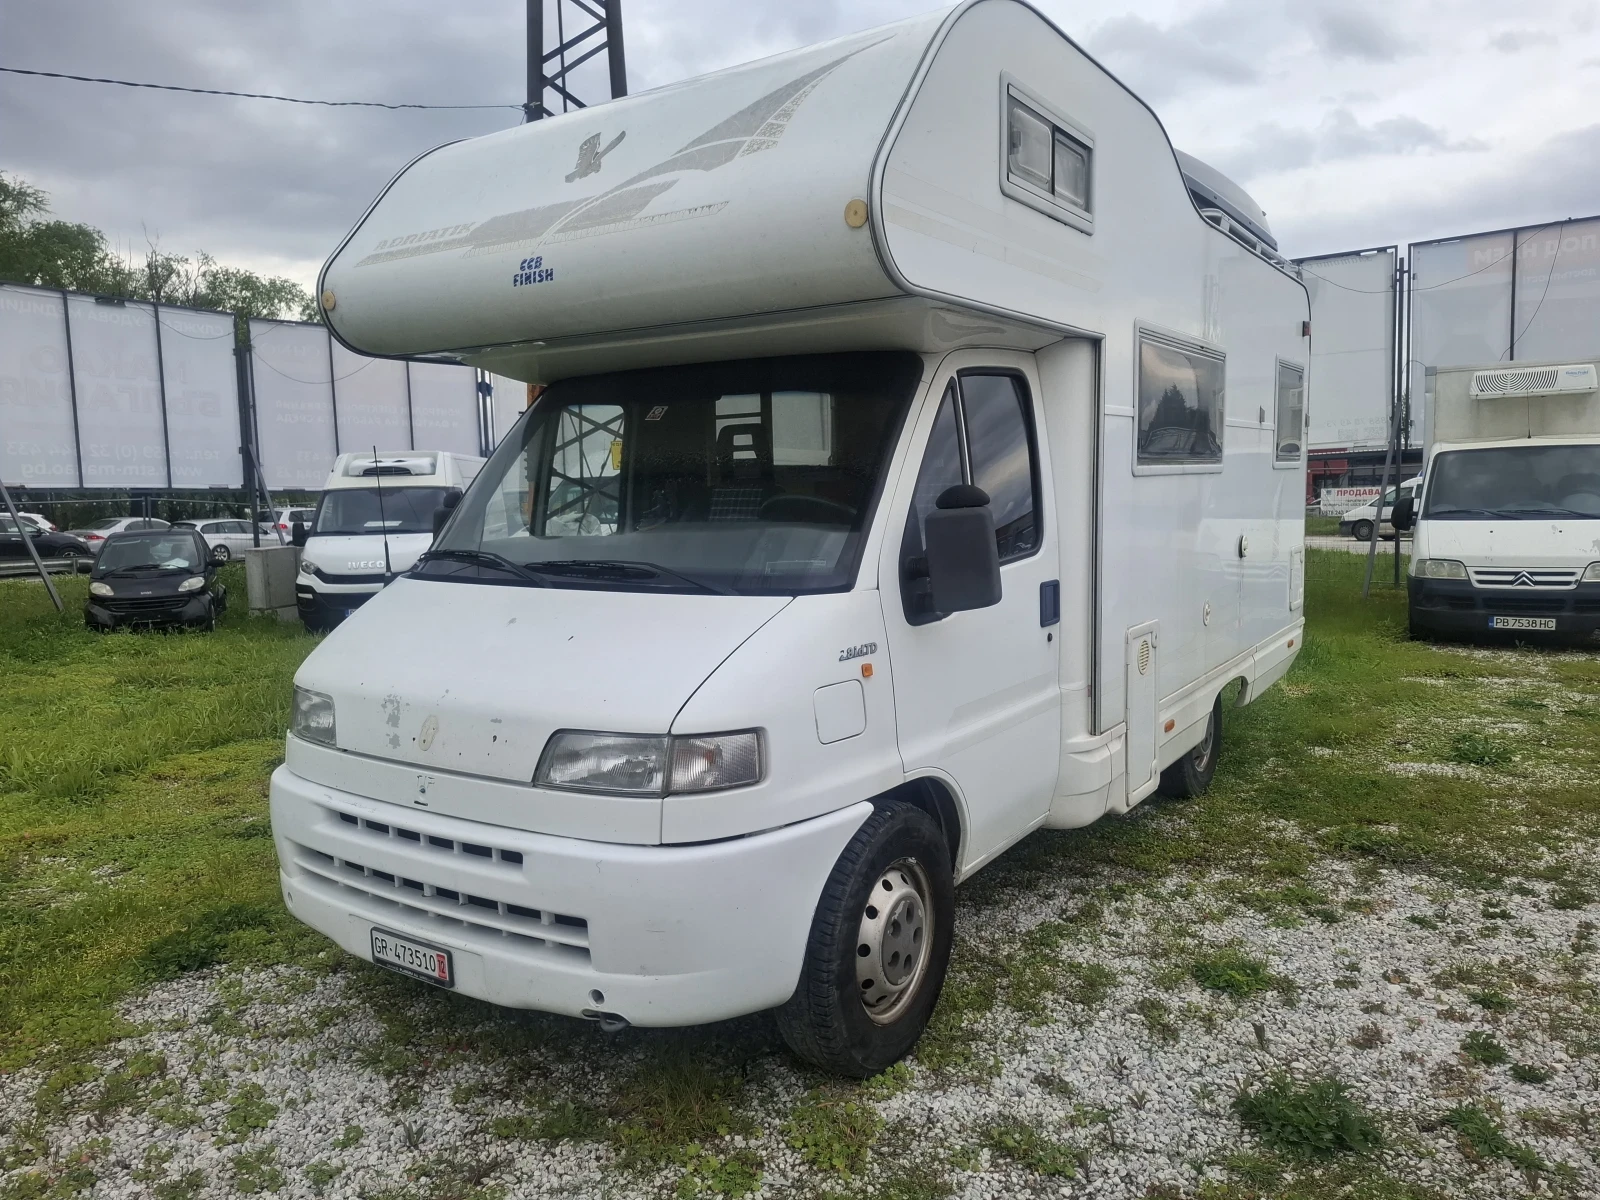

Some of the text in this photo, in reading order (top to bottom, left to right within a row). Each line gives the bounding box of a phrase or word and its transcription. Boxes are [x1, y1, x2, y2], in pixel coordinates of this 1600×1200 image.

[513, 268, 554, 287] FINISH
[347, 560, 385, 570] IVECO
[1495, 618, 1554, 629] PB 7538 HC
